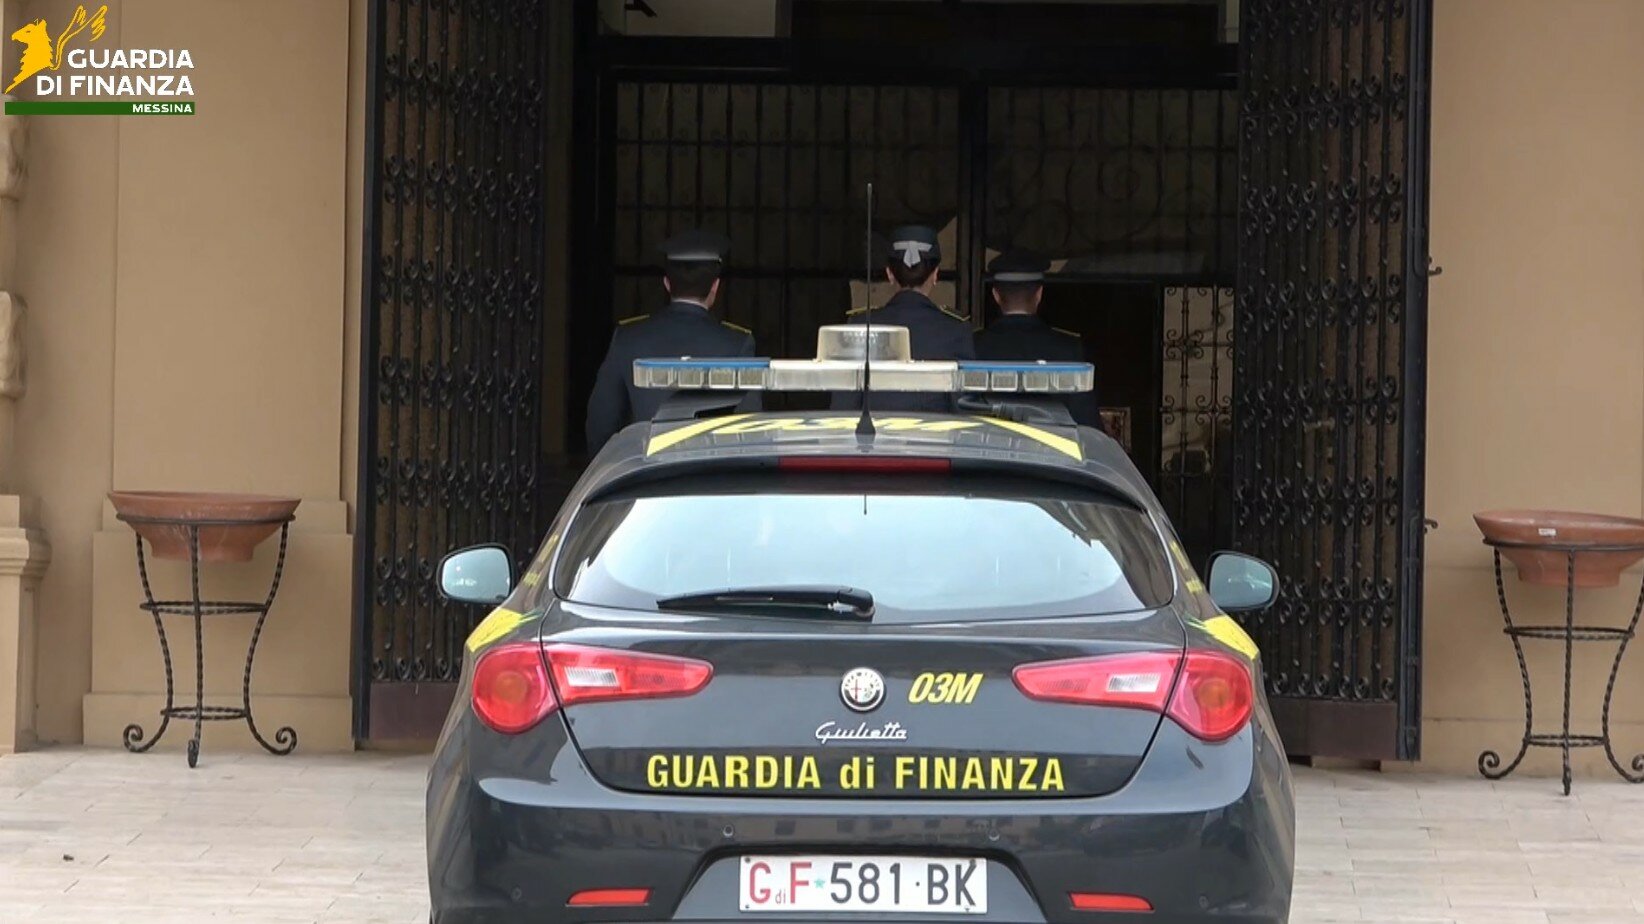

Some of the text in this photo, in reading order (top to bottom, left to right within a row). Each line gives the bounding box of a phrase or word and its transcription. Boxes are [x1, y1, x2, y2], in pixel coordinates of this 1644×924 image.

[908, 672, 983, 704] 03M
[815, 721, 907, 744] Giulietta
[647, 755, 1064, 791] GUARDIA di FINANZA
